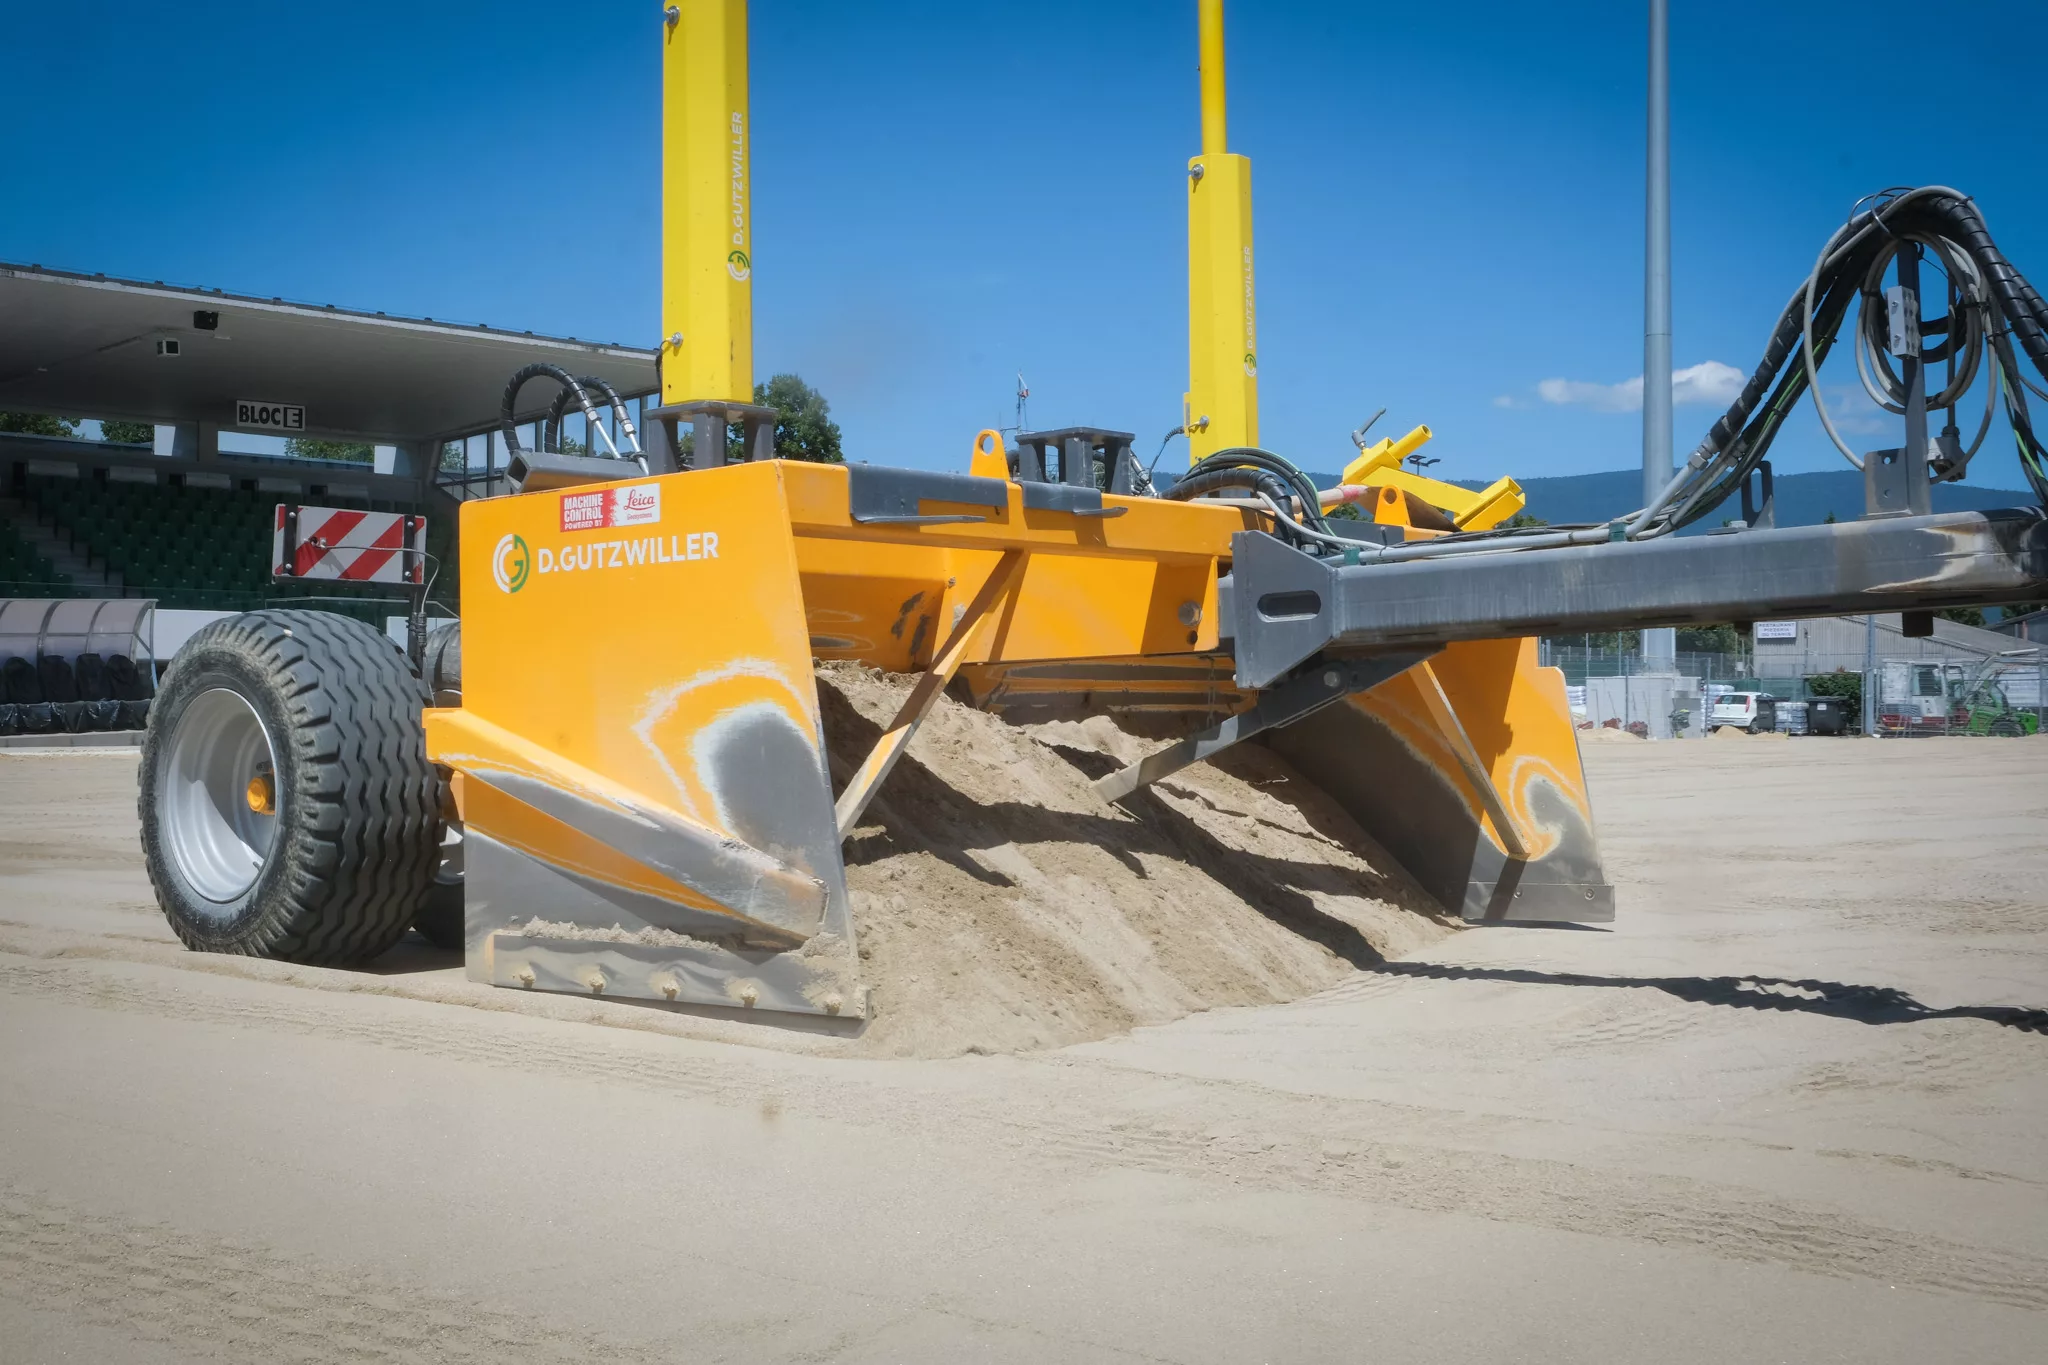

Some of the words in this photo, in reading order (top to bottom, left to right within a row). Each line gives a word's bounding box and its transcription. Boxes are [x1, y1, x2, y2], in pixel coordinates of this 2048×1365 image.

[732, 112, 743, 244] D.GUTZWILLER
[1244, 246, 1253, 349] D.GUTZWILLER
[239, 405, 281, 425] BLOC
[285, 407, 302, 428] E
[564, 494, 603, 509] MACHINE
[623, 489, 655, 511] Leica
[564, 505, 603, 522] CONTROL
[564, 520, 594, 530] POWERED
[594, 519, 603, 527] BY
[538, 531, 719, 574] D.GUTZWILLER
